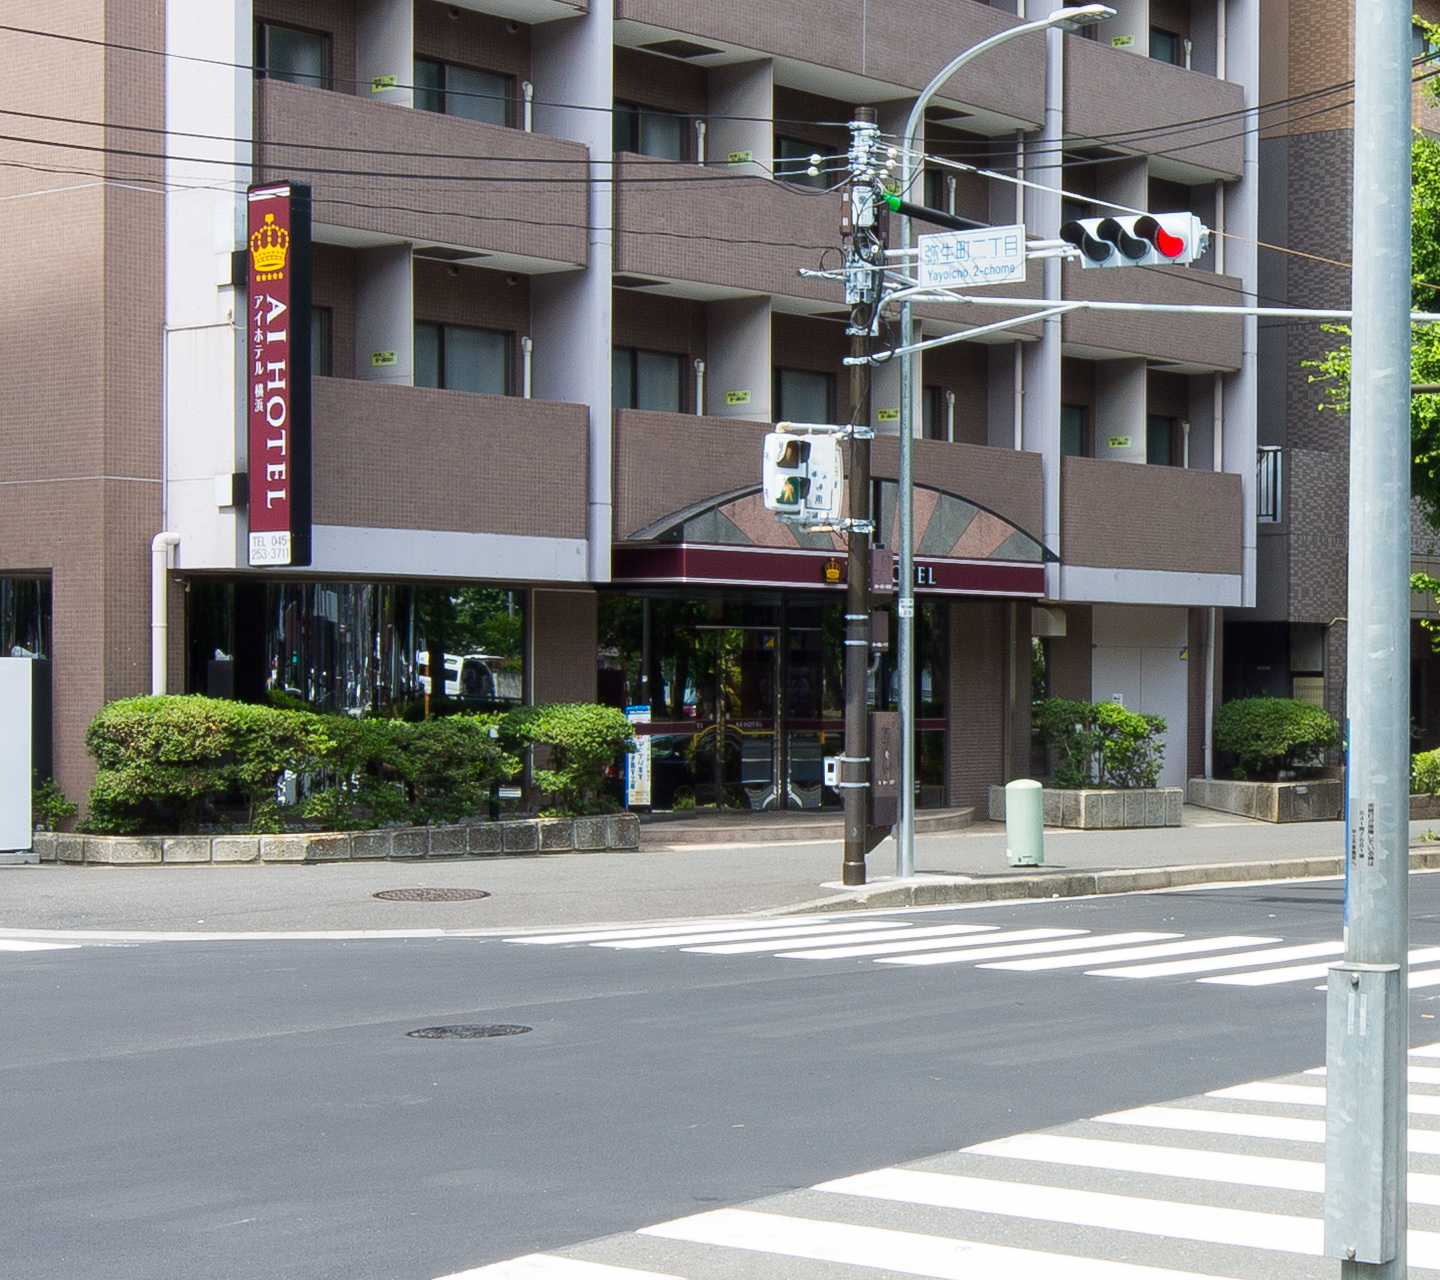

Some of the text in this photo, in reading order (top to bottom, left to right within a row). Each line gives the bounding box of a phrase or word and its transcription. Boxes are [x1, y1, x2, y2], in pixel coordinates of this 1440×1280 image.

[925, 235, 1018, 265] 弥生町二丁目
[927, 264, 1016, 282] Yayoicho 2-chome
[254, 295, 264, 375] アイホテル
[266, 294, 287, 509] AI HOTEL
[251, 548, 289, 559] 253-3711
[252, 536, 266, 547] TEL
